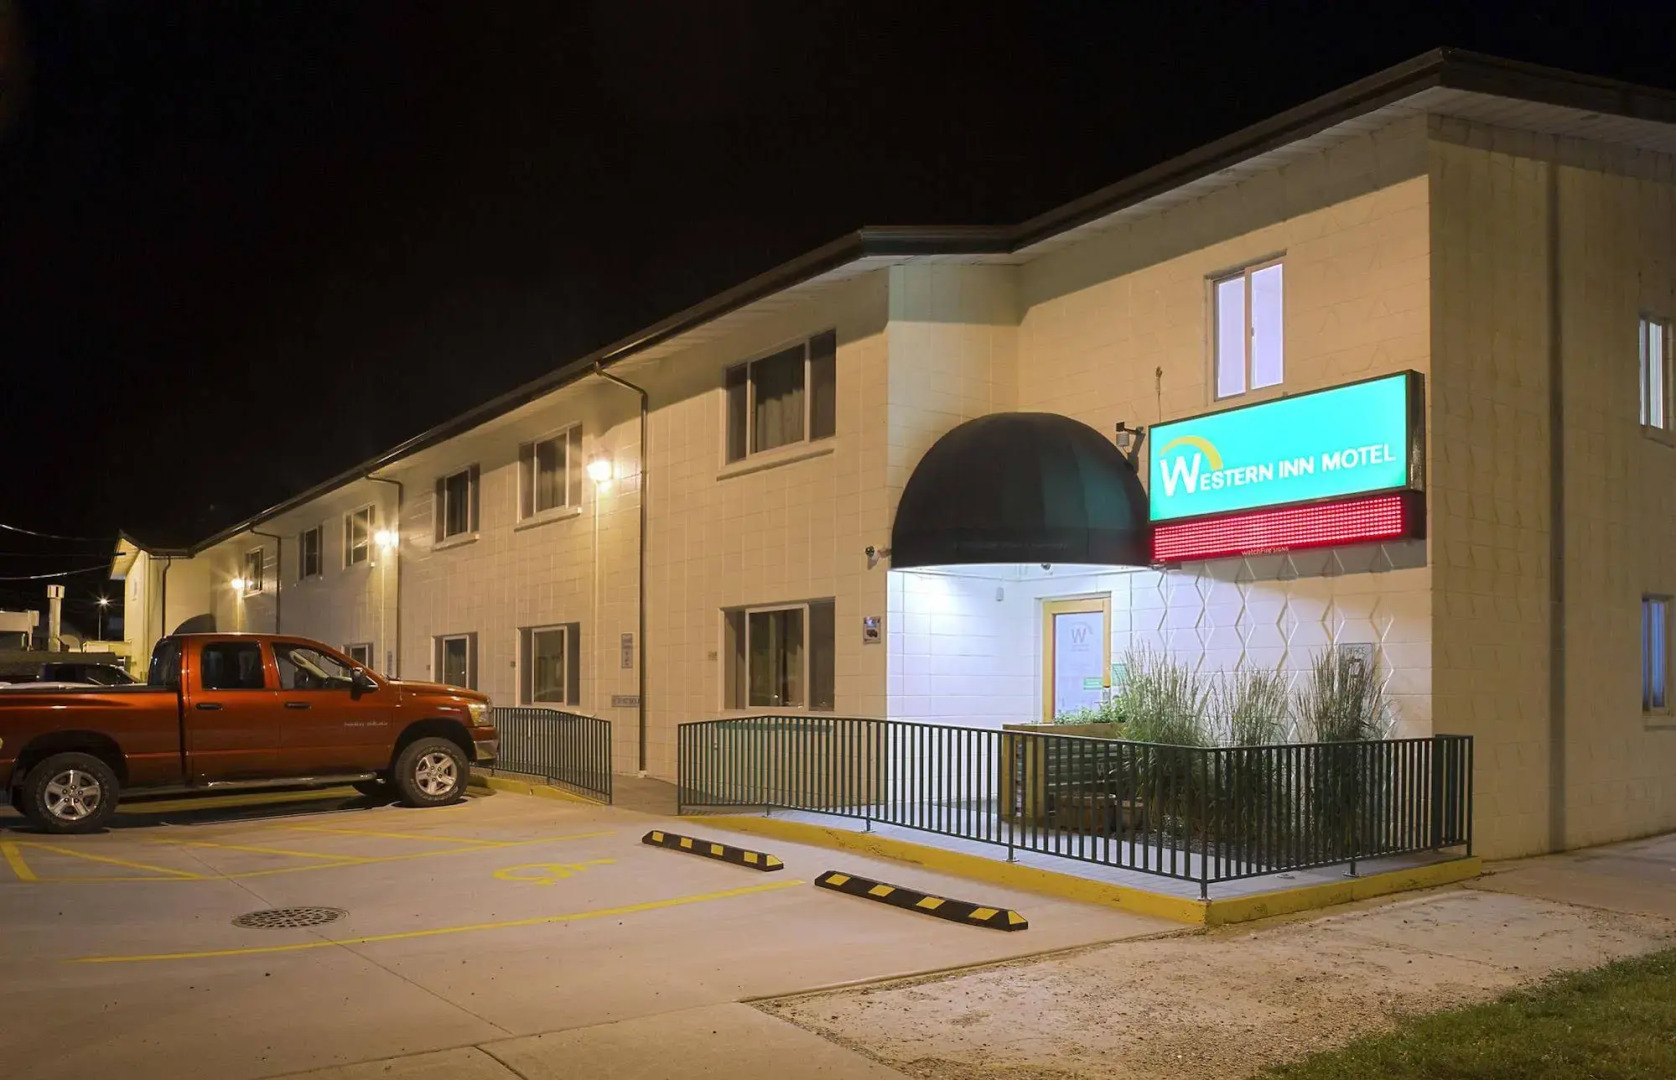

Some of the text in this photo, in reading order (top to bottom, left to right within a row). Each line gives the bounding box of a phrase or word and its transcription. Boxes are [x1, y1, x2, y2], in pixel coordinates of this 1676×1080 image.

[1160, 444, 1397, 497] WESTERN INN MOTEL
[1071, 628, 1086, 643] W
